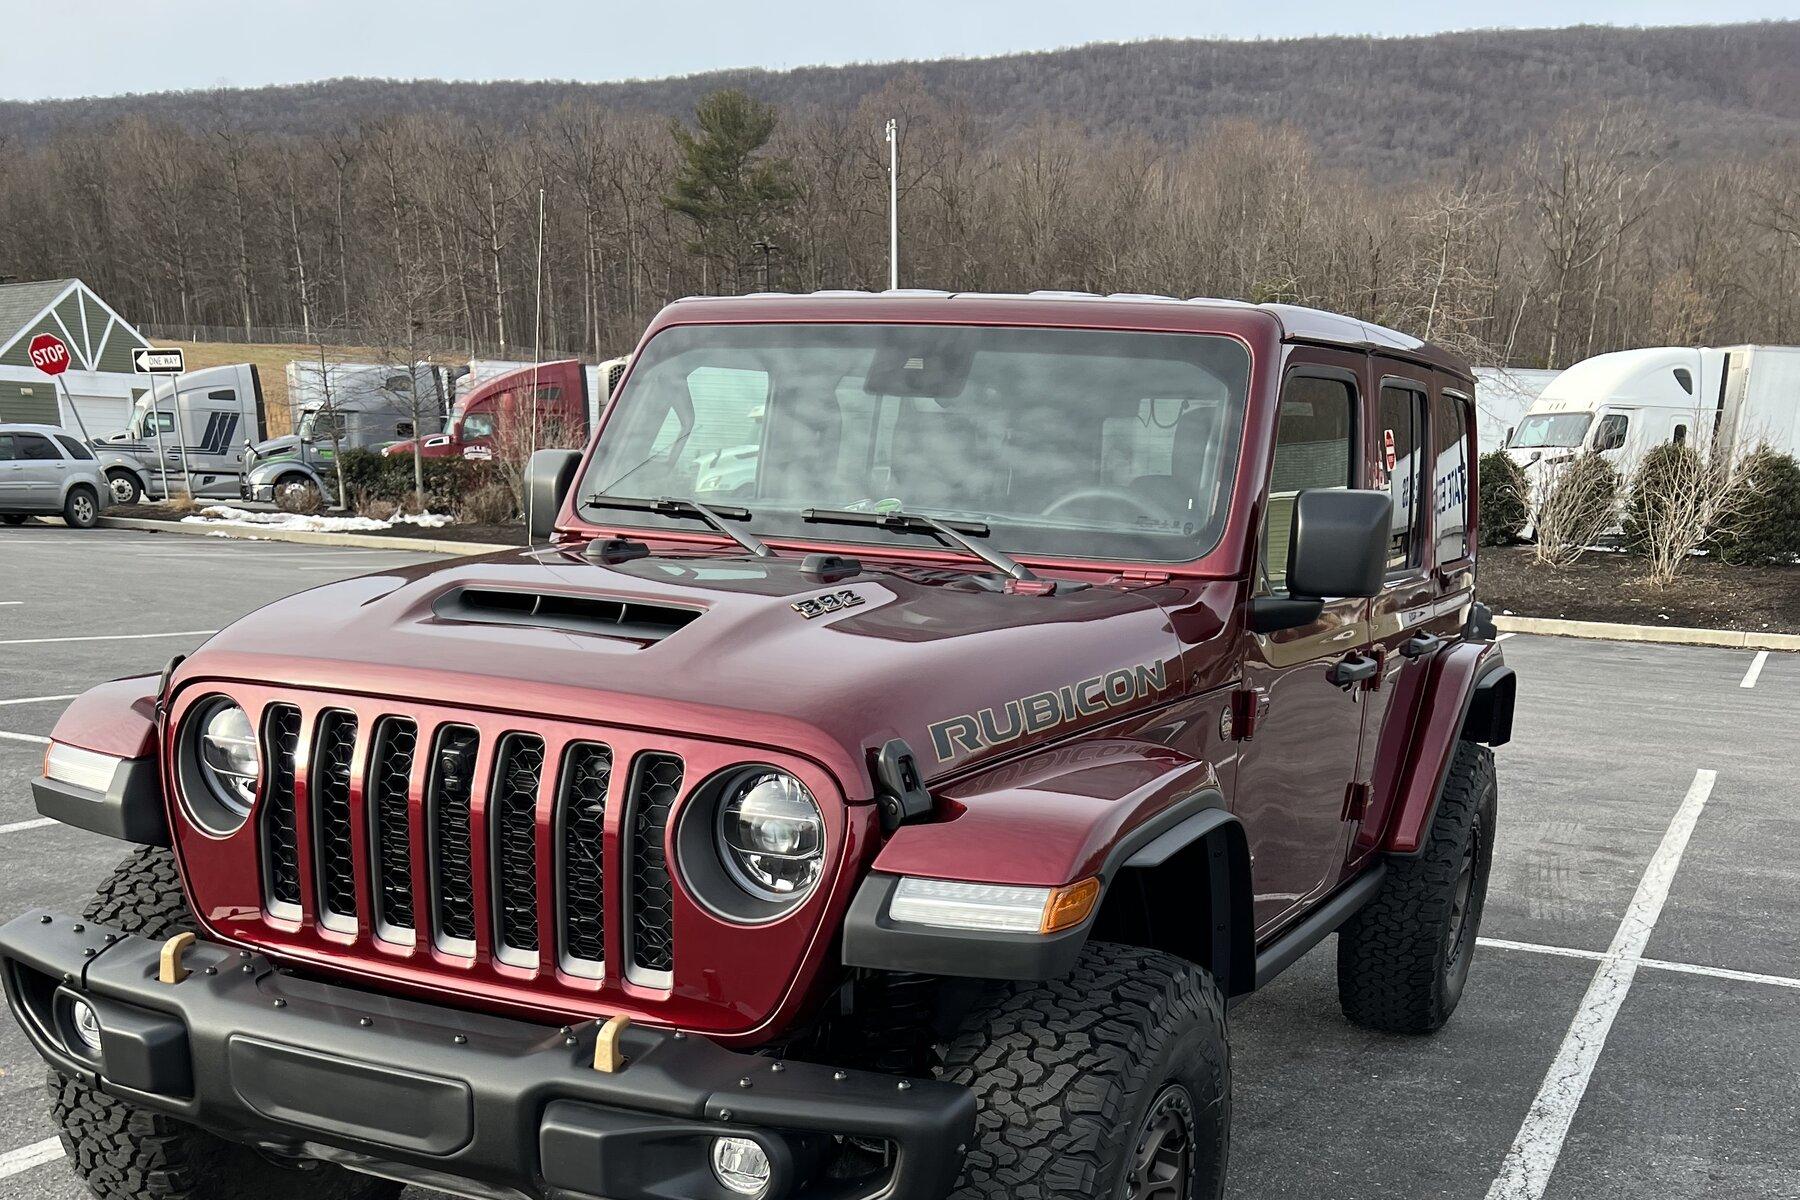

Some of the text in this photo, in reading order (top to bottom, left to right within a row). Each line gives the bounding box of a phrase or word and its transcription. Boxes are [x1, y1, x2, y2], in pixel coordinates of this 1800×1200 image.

[33, 344, 64, 366] STOP
[149, 356, 178, 365] ONE WAY
[790, 589, 866, 619] 392
[926, 658, 1167, 764] RUBICON
